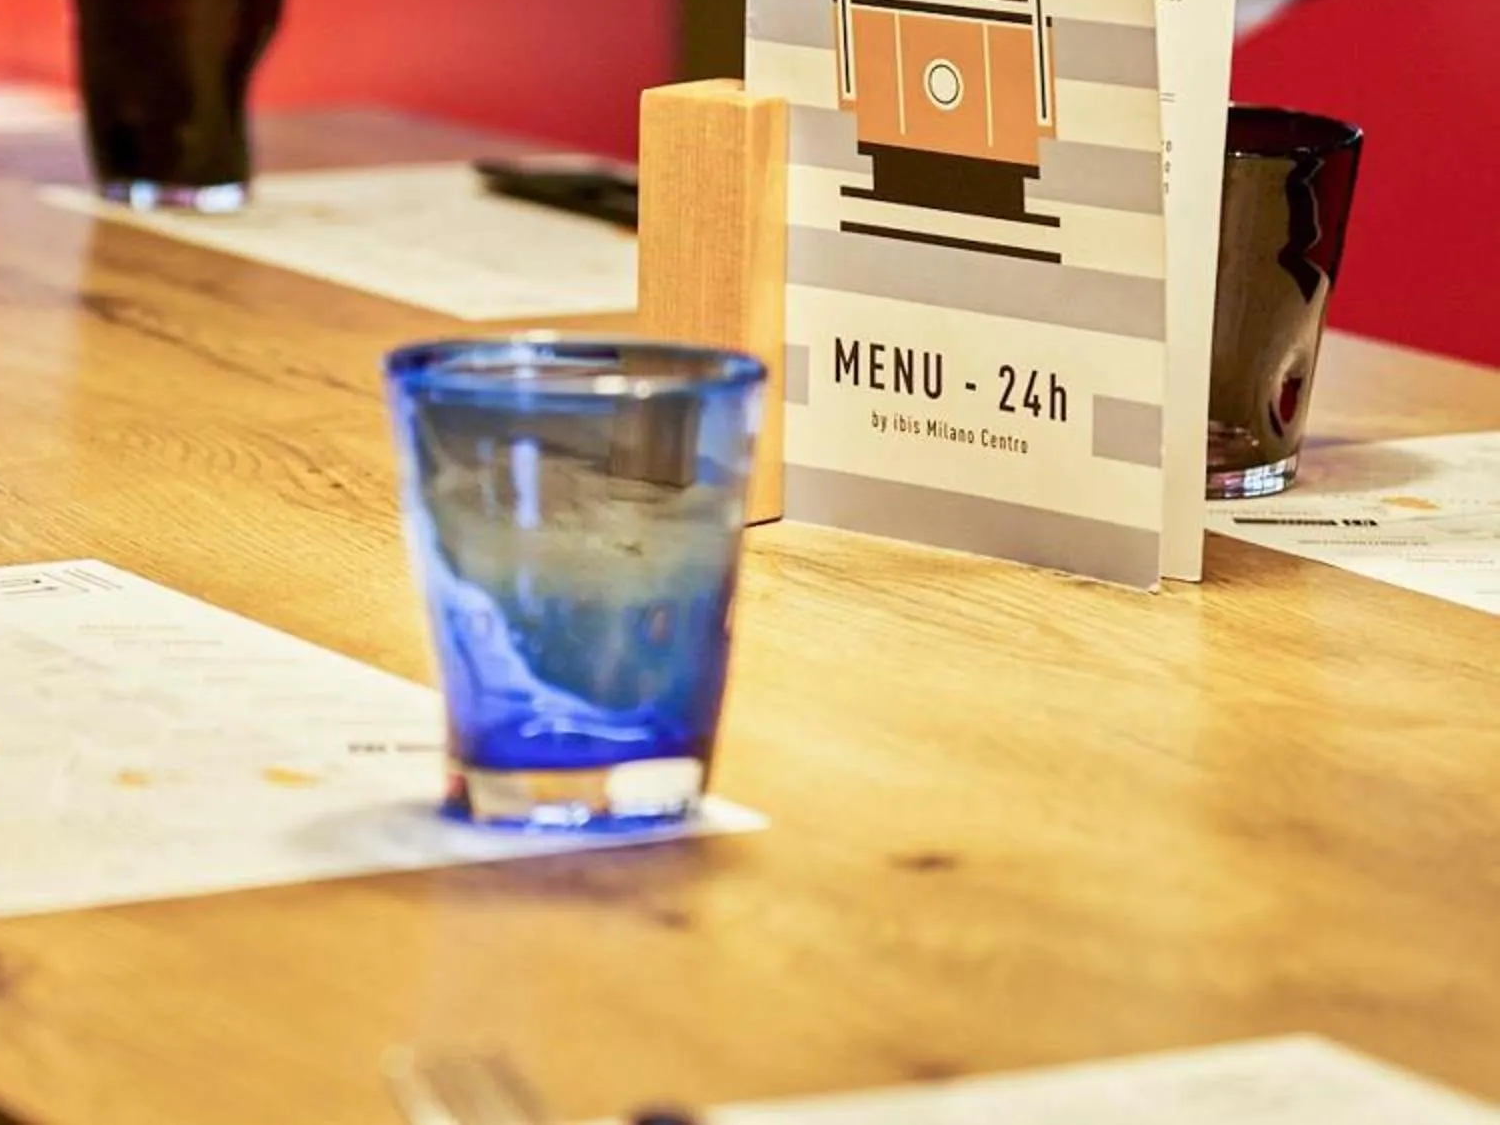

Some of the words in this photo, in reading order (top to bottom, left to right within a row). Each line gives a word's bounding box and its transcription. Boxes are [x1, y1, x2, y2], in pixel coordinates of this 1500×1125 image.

[834, 337, 943, 400] MENU
[998, 364, 1068, 422] 24h
[871, 411, 888, 432] by
[893, 412, 921, 435] ibis
[926, 418, 975, 444] Milano
[980, 428, 1029, 454] Centro
